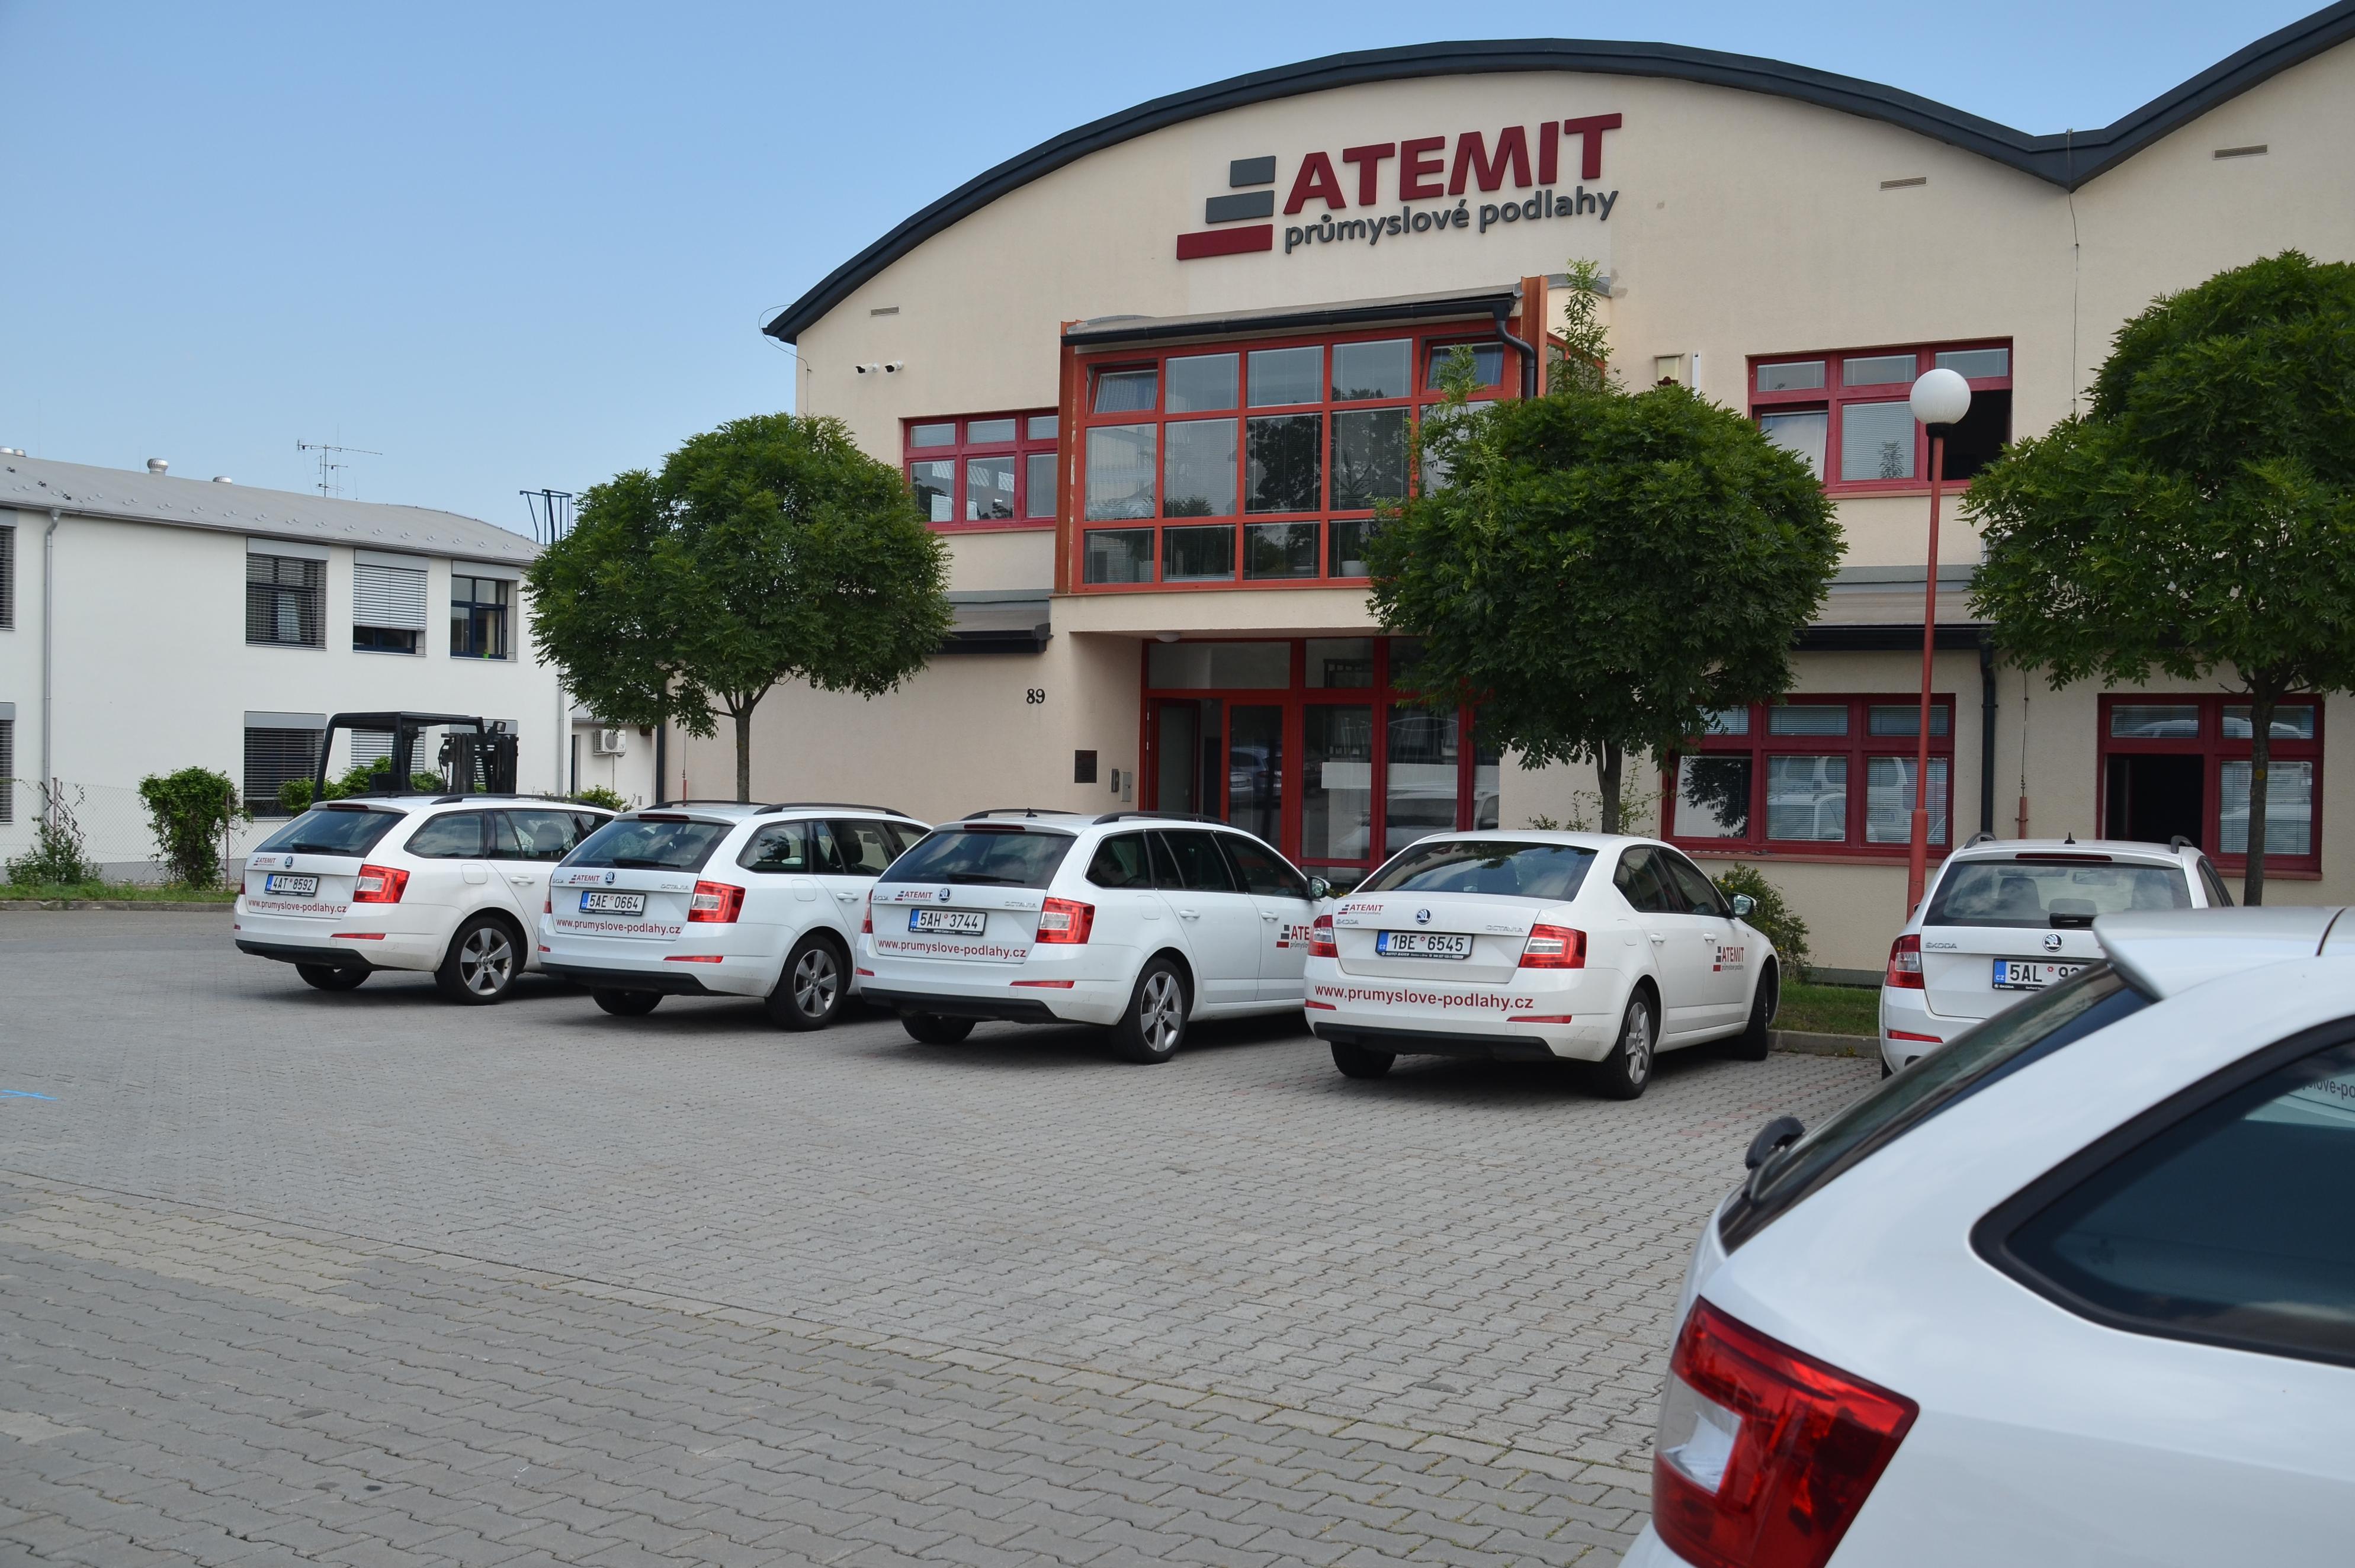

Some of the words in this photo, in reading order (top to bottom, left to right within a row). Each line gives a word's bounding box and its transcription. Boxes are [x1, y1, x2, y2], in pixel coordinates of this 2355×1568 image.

[1283, 113, 1622, 215] ATEMIT
[1285, 199, 1470, 253] průmyslové
[1480, 185, 1619, 232] podlahy
[1026, 689, 1045, 704] 89
[273, 877, 288, 889] 4AT
[293, 878, 313, 891] 8592
[248, 899, 346, 914] www.prumyslove-podlahy.cz
[589, 895, 608, 908] 5AE
[615, 897, 639, 909] 0664
[556, 919, 681, 936] www.prumyslove-podlahy.cz
[920, 912, 942, 927] 5AH
[949, 914, 977, 928] 3744
[1291, 926, 1310, 940] ATE
[878, 939, 1026, 959] www.prumyslove-podlahy.cz
[1392, 935, 1417, 950] 1BE
[1427, 936, 1464, 952] 6545
[1722, 947, 1744, 962] ATEMIT
[2010, 964, 2042, 982] 5AL
[1315, 985, 1534, 1011] www.prumyslove-podlahy.cz
